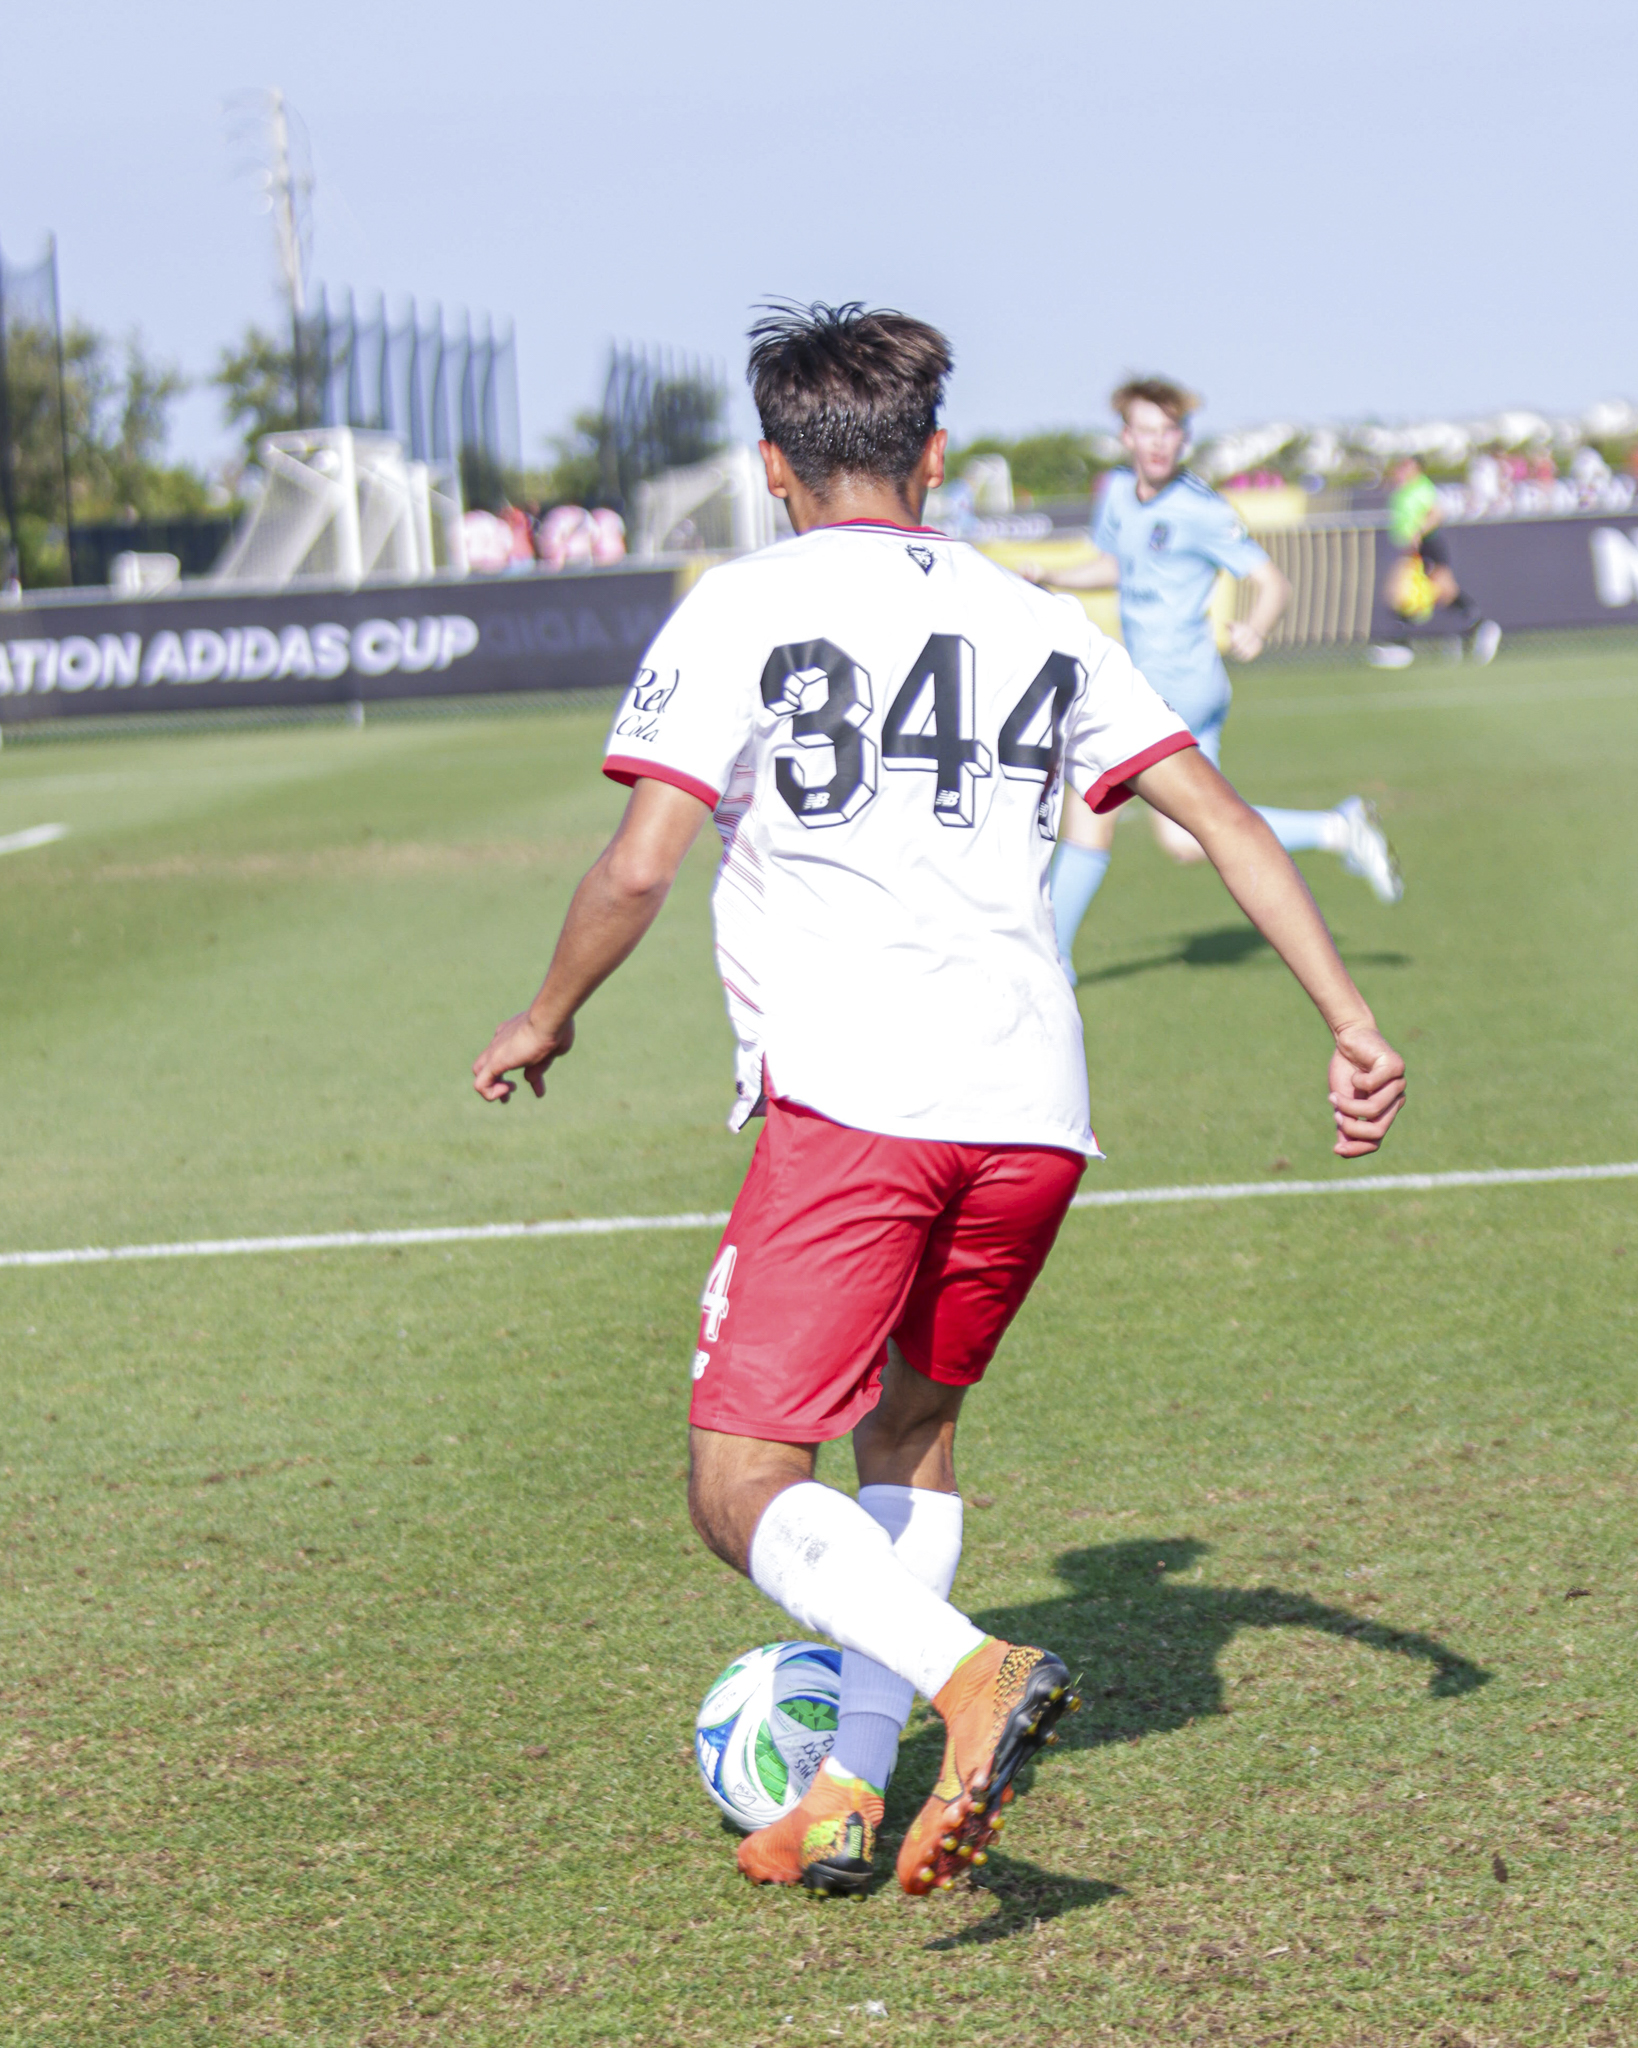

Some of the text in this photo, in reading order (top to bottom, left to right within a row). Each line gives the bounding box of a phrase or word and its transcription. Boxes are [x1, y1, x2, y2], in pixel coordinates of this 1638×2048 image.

[0, 632, 142, 696] TION
[140, 621, 350, 687] ADIDAS
[350, 614, 480, 677] CUP
[633, 667, 680, 715] Red
[616, 714, 660, 743] Cola
[801, 1741, 823, 1771] EXT
